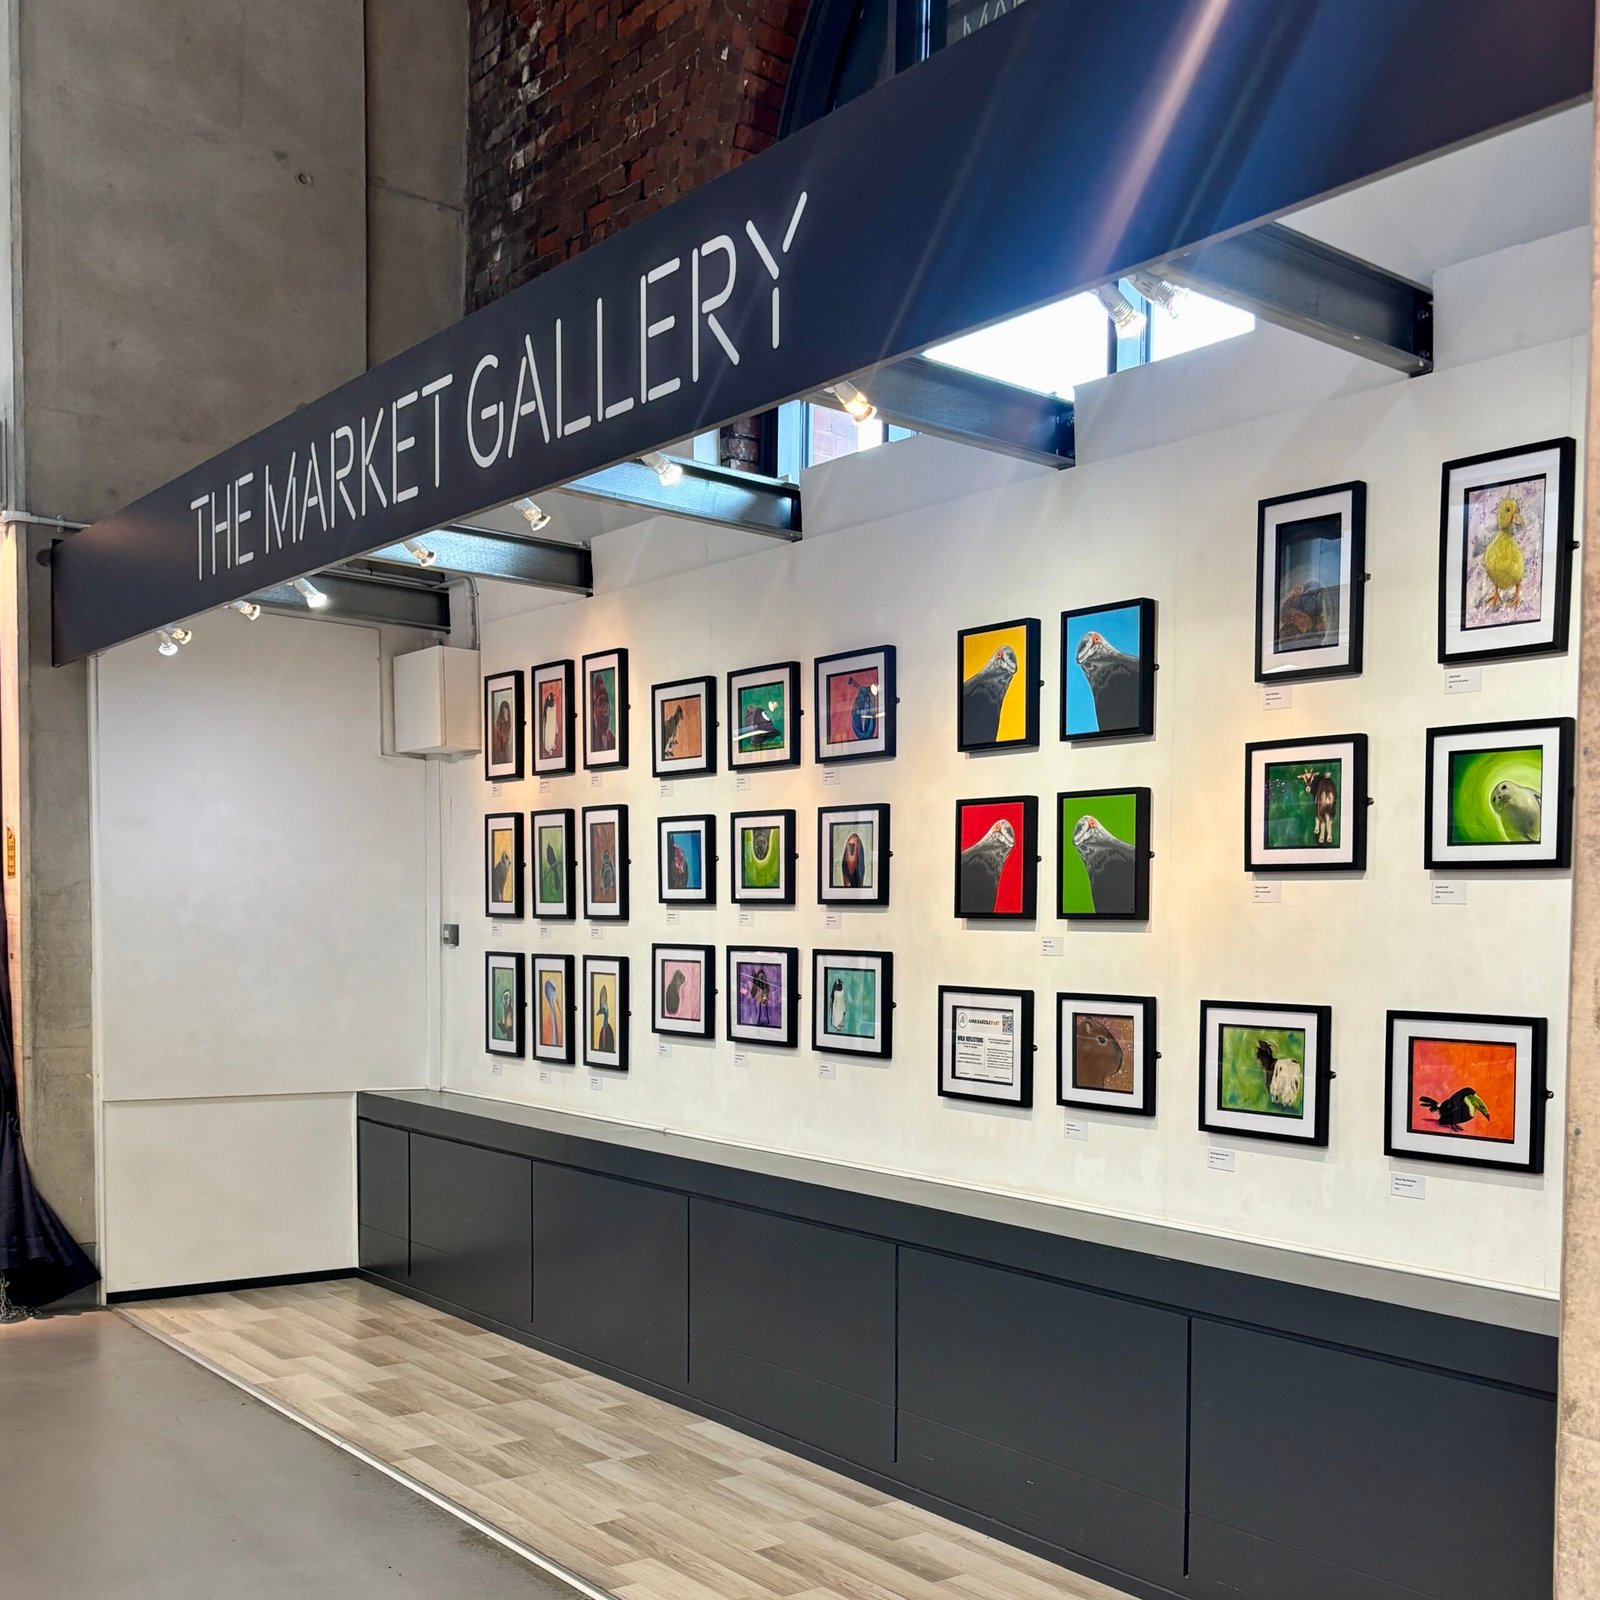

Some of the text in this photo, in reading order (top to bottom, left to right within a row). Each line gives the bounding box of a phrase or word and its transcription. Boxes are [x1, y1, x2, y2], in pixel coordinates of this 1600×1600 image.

[190, 190, 808, 581] THE MARKET GALLERY
